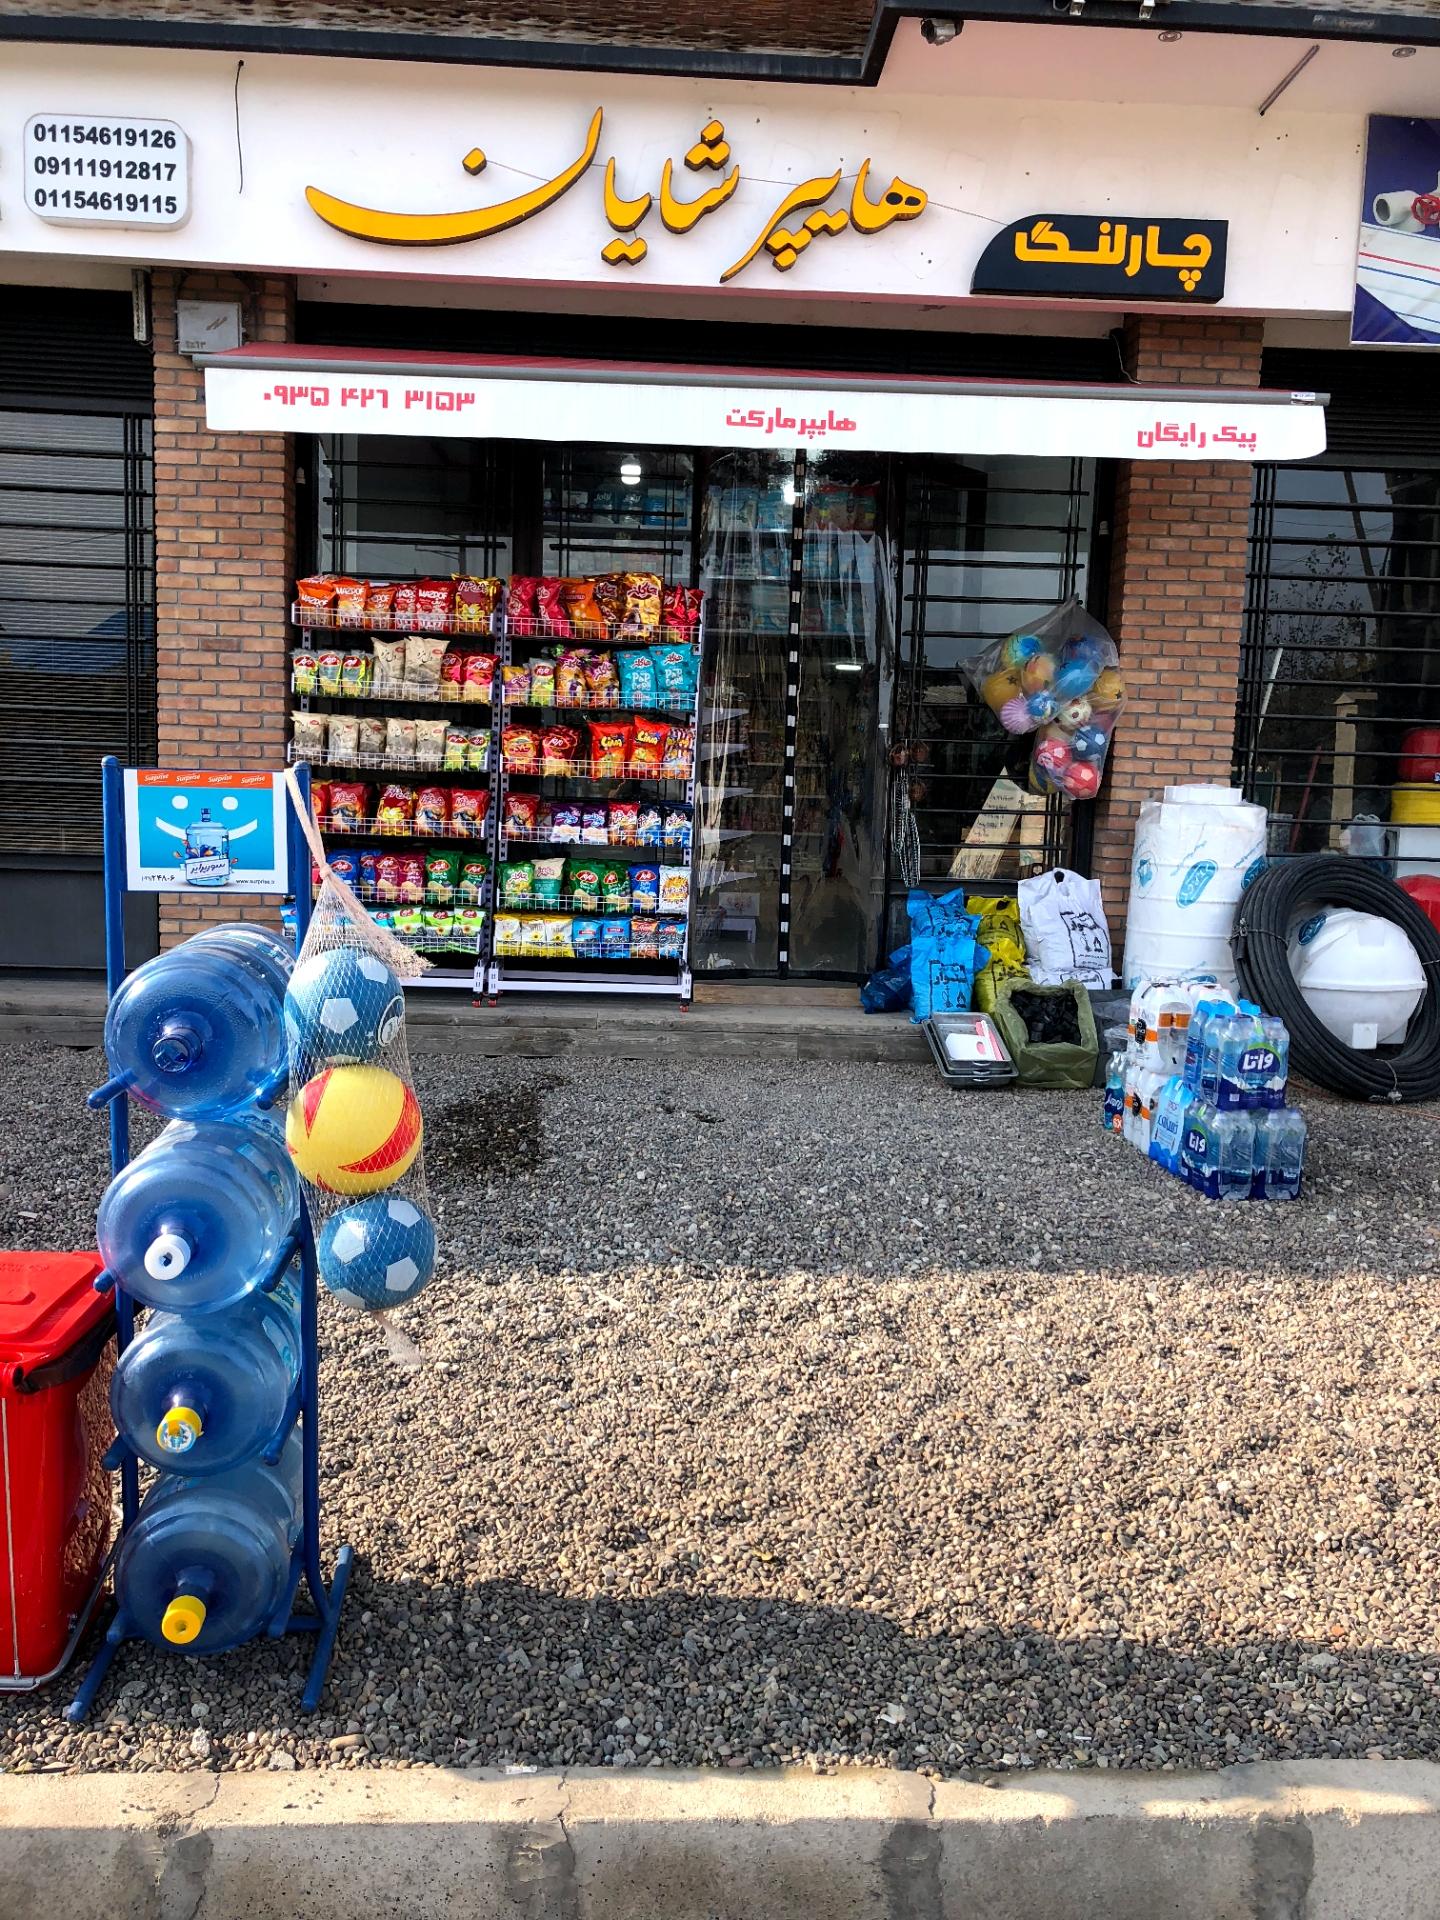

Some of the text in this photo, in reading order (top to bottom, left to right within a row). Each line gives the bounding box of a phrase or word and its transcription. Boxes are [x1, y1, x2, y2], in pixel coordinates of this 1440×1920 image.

[33, 123, 176, 149] 01154619126
[34, 156, 177, 182] 09111912817
[34, 188, 177, 214] 01154619115
[304, 106, 929, 284] هایپر شایان
[1014, 220, 1213, 293] چارلنگ
[1137, 421, 1258, 452] پیک رایگان
[1242, 1052, 1274, 1071] واتا
